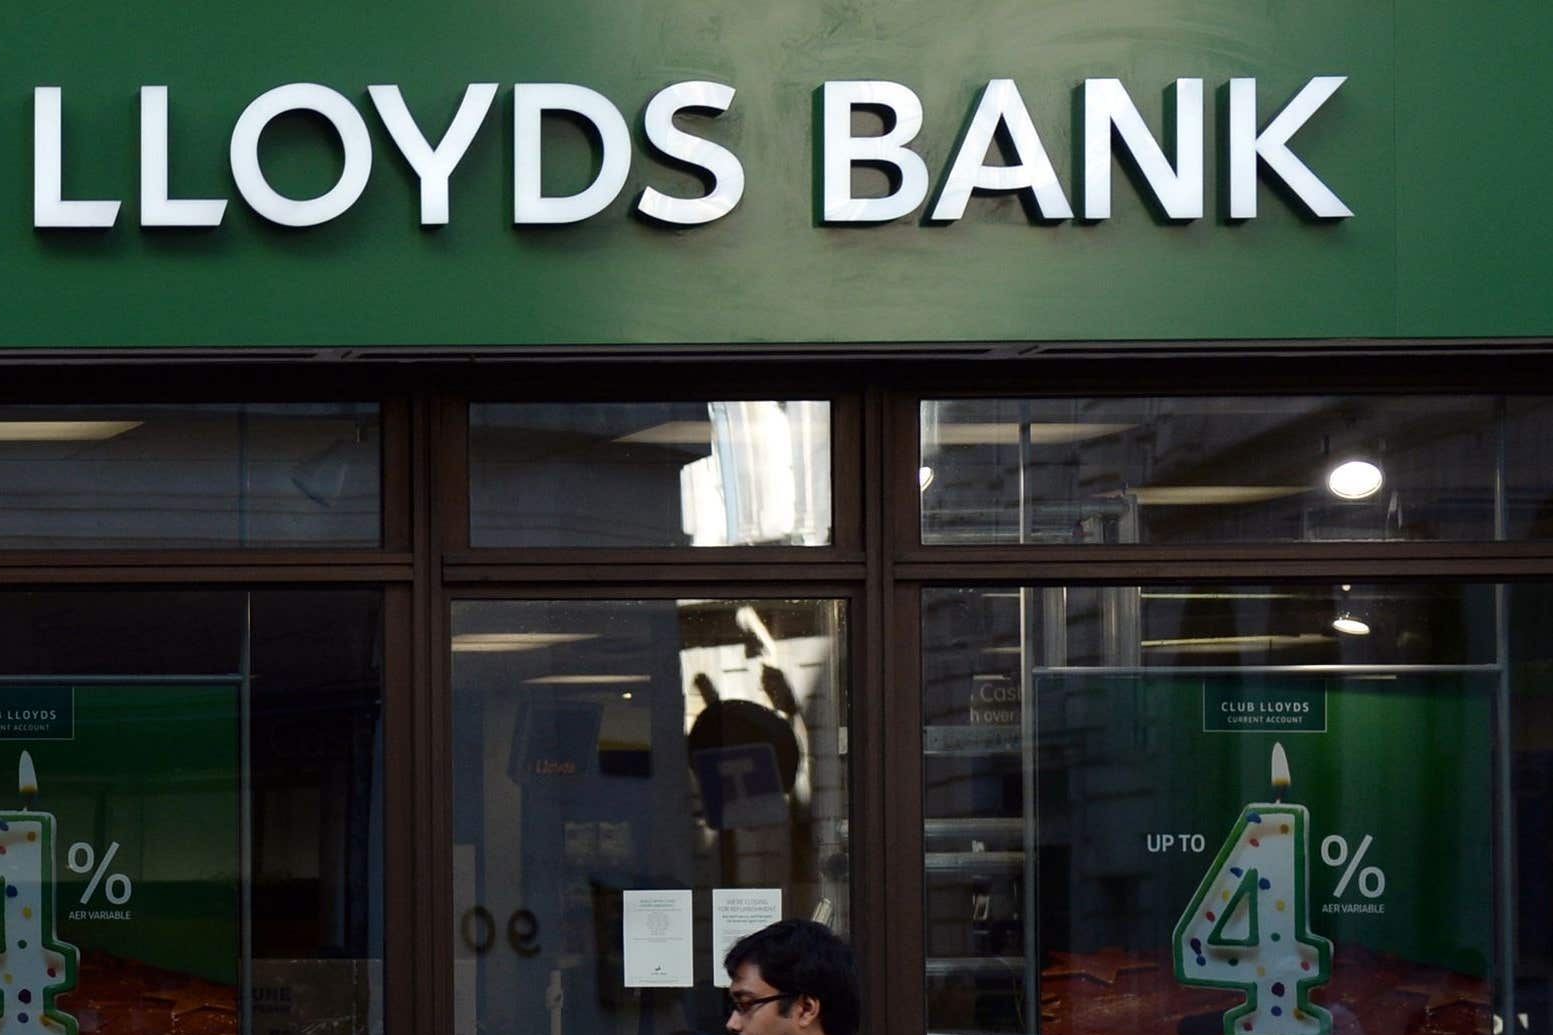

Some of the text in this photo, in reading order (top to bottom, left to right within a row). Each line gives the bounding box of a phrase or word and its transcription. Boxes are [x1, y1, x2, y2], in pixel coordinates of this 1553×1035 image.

[32, 75, 1354, 230] LLOYDS BANK
[980, 683, 1021, 703] Cas
[1221, 702, 1310, 712] CLUB LLOYDS
[7, 709, 57, 720] LLOYDS
[1227, 715, 1303, 723] CURRENT ACCOUNT
[13, 723, 49, 731] ACCOUNT
[1147, 834, 1206, 854] UP TO
[1322, 903, 1385, 914] AER VARIABLE
[68, 909, 132, 921] AER VARIABLE
